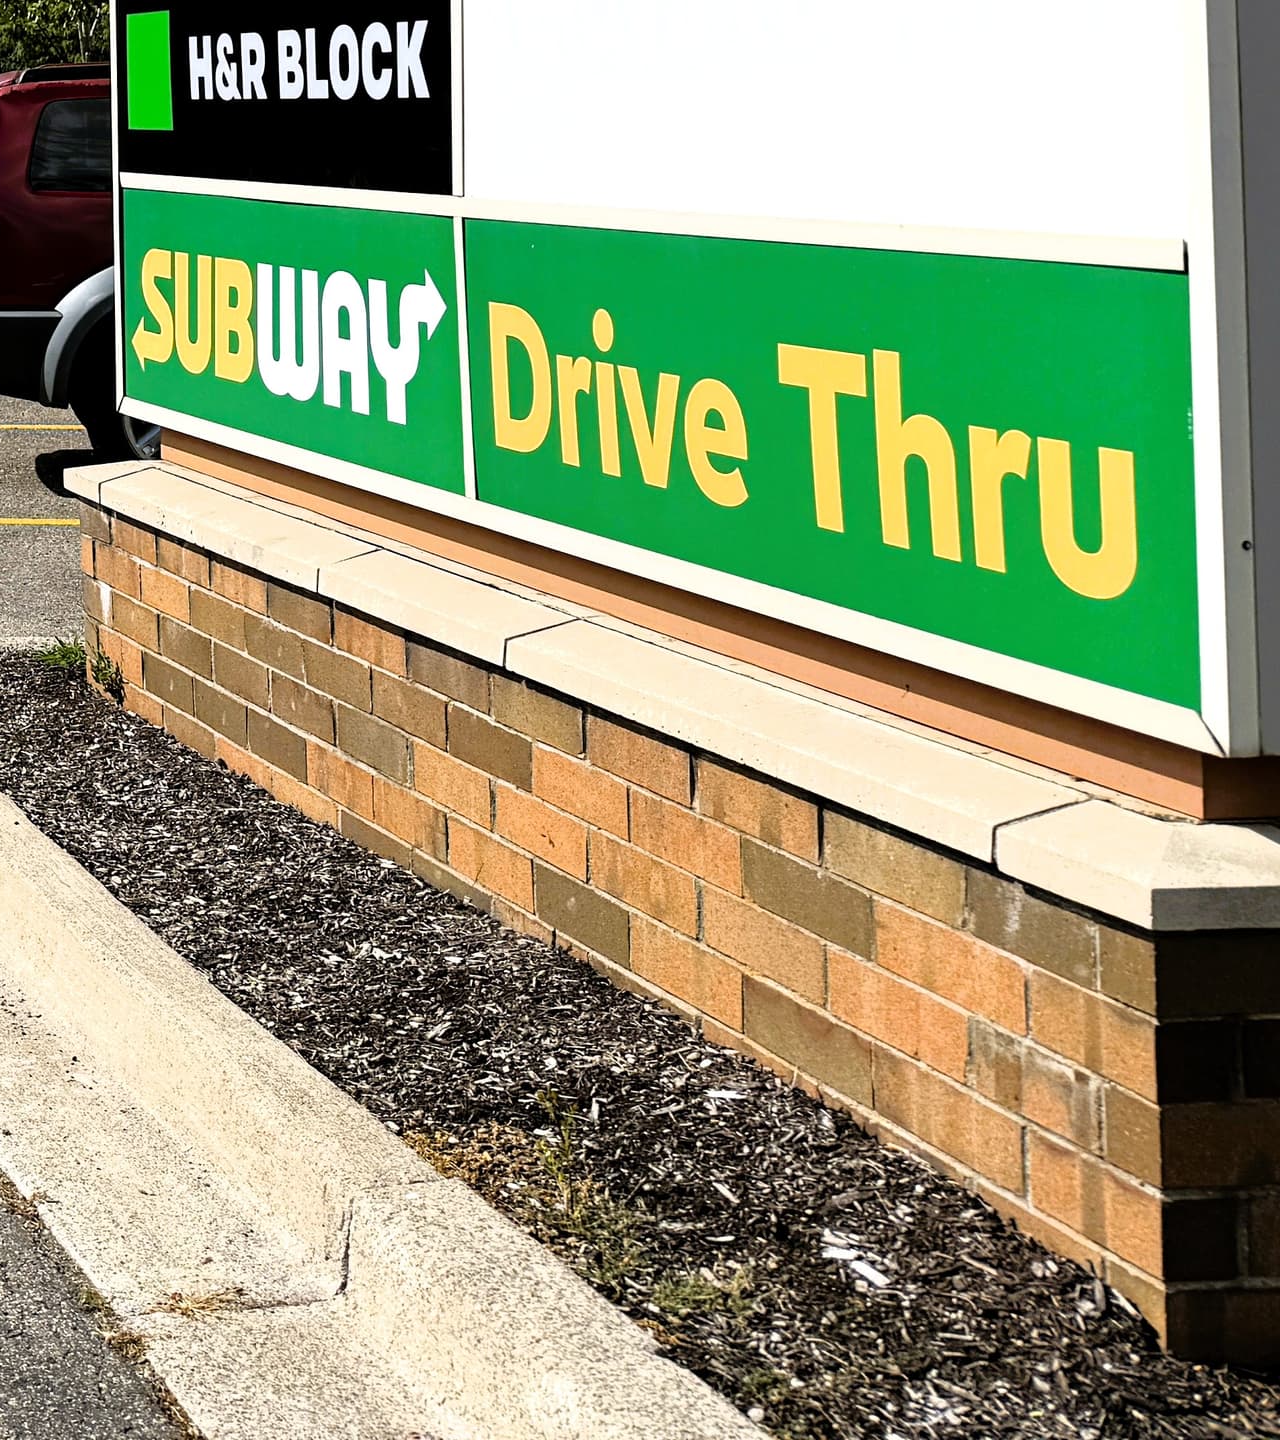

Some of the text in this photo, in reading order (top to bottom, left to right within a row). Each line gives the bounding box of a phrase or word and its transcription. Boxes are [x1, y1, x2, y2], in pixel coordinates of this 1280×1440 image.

[188, 20, 431, 101] H&R BLOCK
[131, 248, 448, 426] SUBWAY
[489, 301, 1138, 600] Drive Thru
